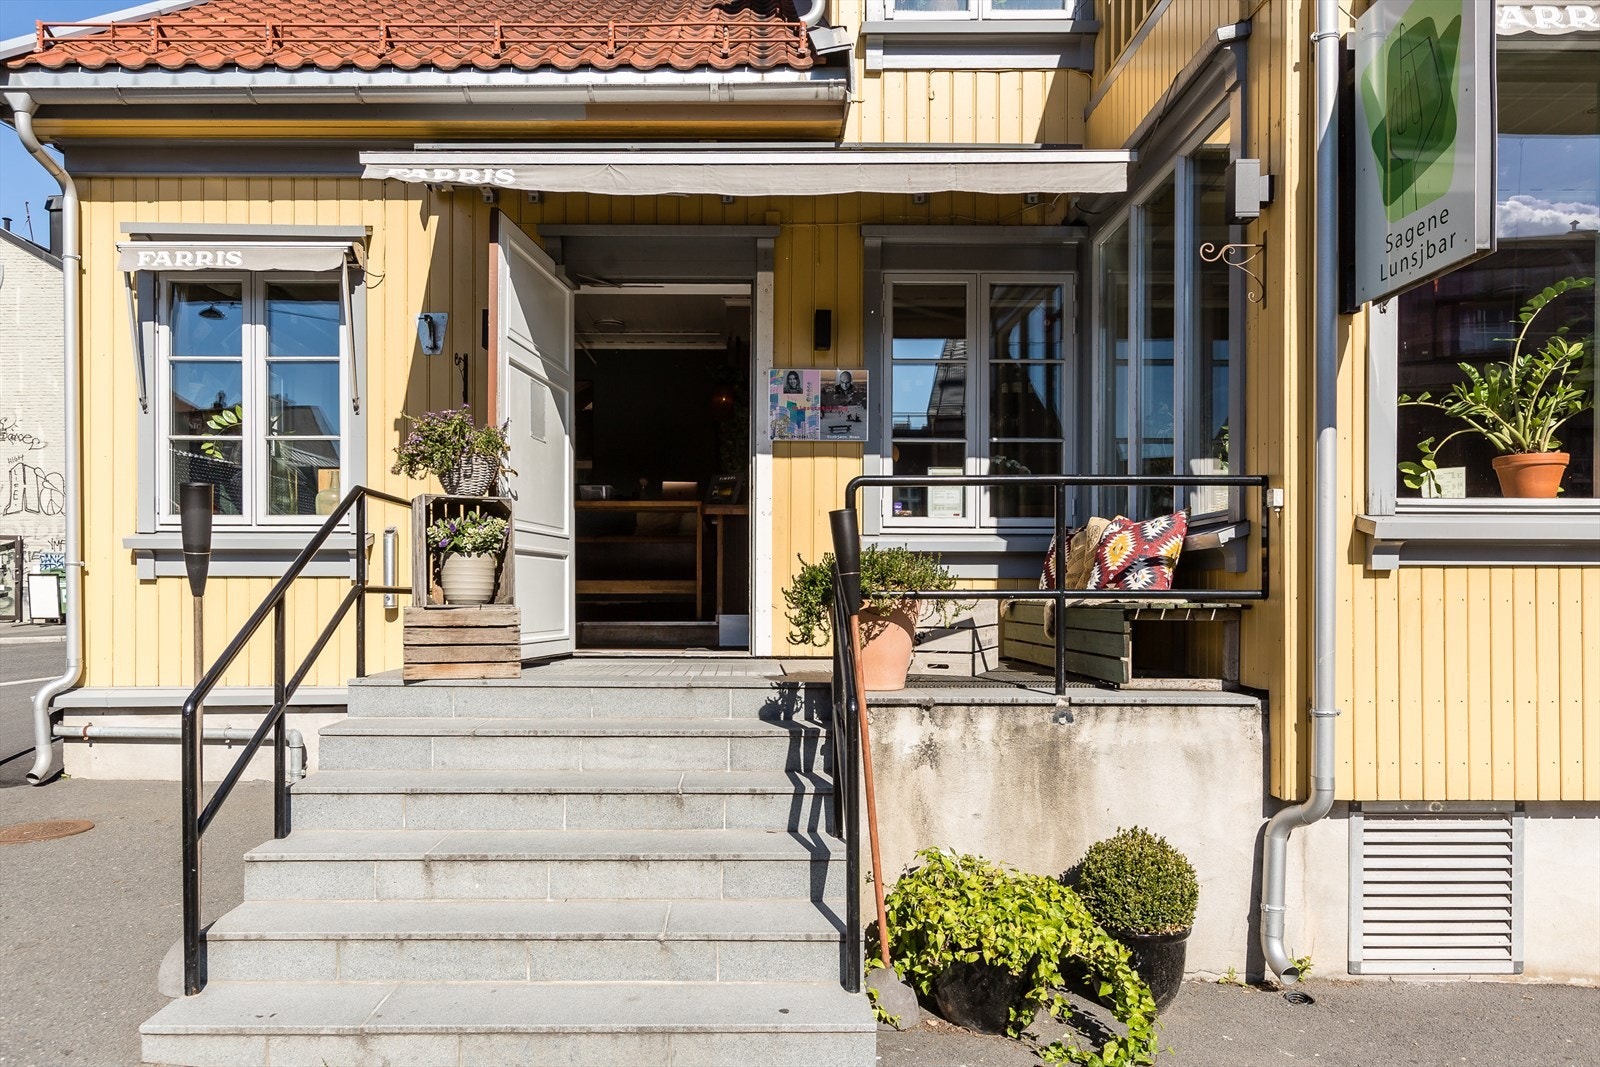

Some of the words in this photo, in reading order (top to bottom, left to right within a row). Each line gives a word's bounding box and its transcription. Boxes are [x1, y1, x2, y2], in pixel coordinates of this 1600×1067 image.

[1496, 5, 1600, 30] ARR
[1385, 208, 1449, 253] Sagene
[137, 250, 244, 267] FARRIS
[1380, 232, 1456, 282] Lunsjbar
